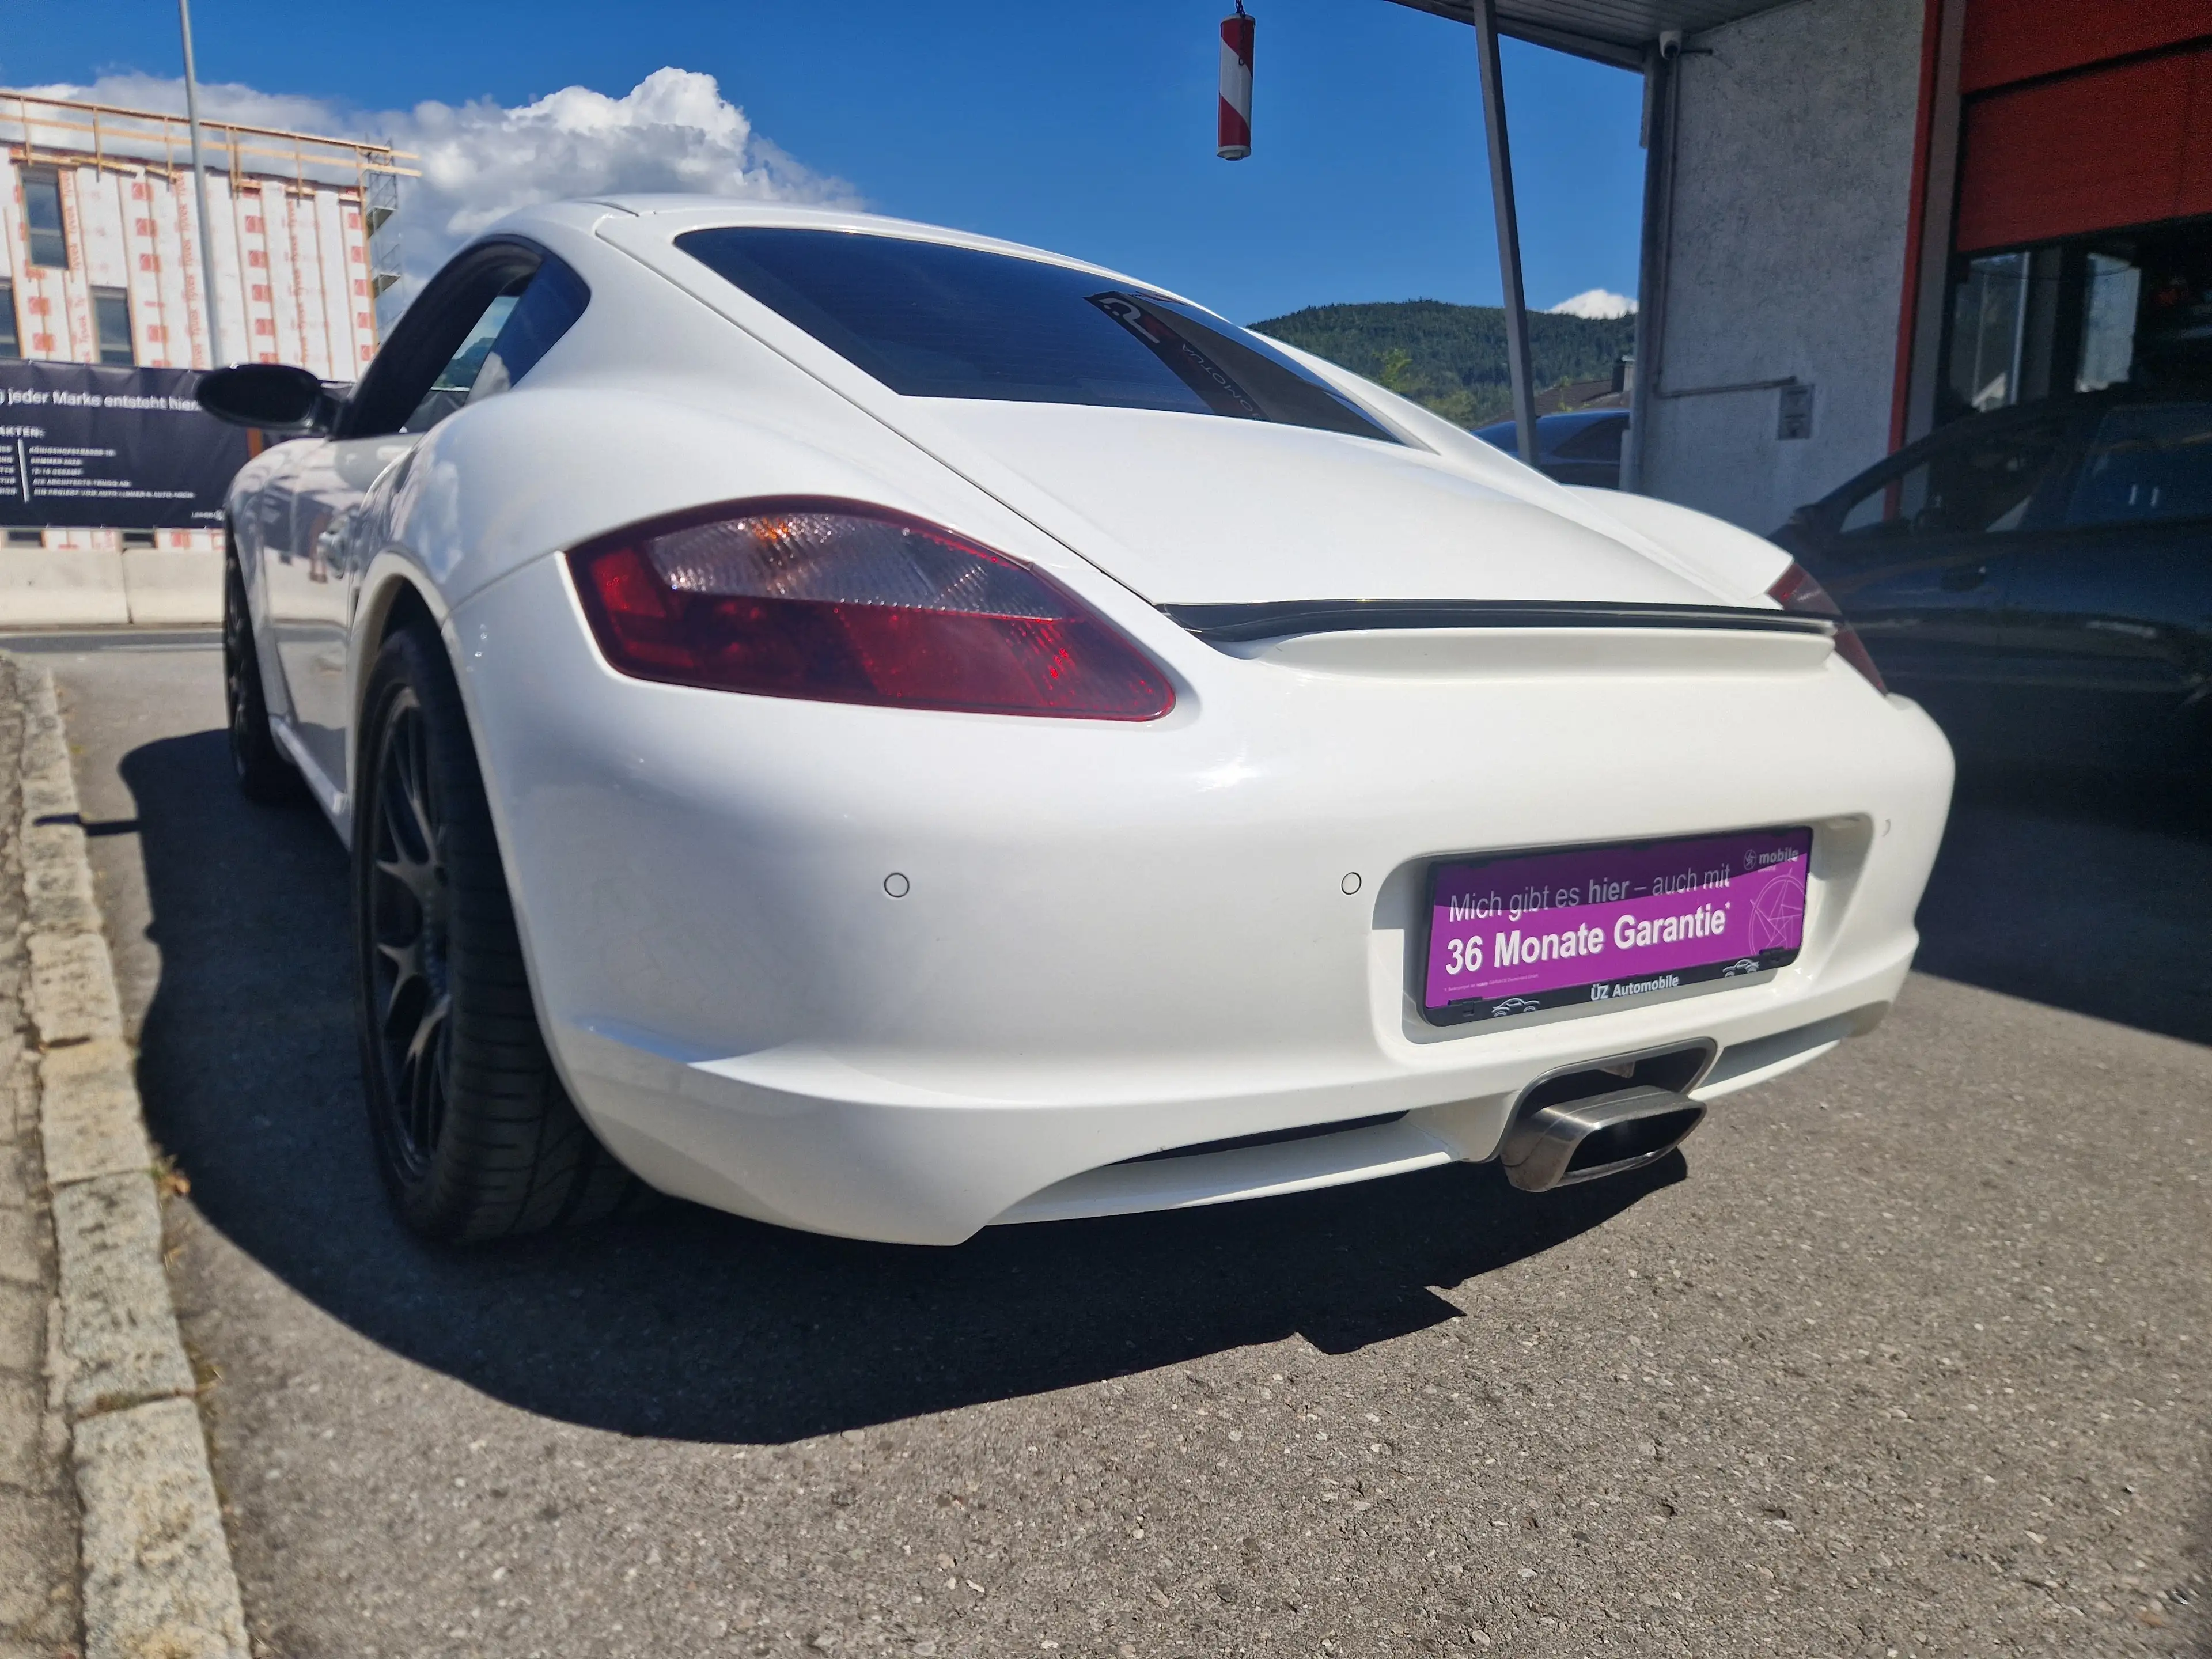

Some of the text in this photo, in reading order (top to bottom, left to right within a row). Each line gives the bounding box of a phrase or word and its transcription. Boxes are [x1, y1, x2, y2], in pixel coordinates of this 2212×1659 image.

[7, 387, 50, 407] jeder
[52, 389, 103, 407] Marke
[104, 395, 167, 410] entsteht
[1758, 847, 1799, 865] mobile
[1449, 891, 1502, 922] Mich
[1509, 885, 1549, 922] gibt
[1555, 887, 1580, 908] es
[1588, 877, 1630, 903] hier
[1652, 868, 1698, 896] auch
[1703, 863, 1730, 890] mit
[1445, 935, 1483, 975] 36
[1494, 922, 1604, 968] Monate
[1590, 974, 1680, 1001] ÜZ Automobile
